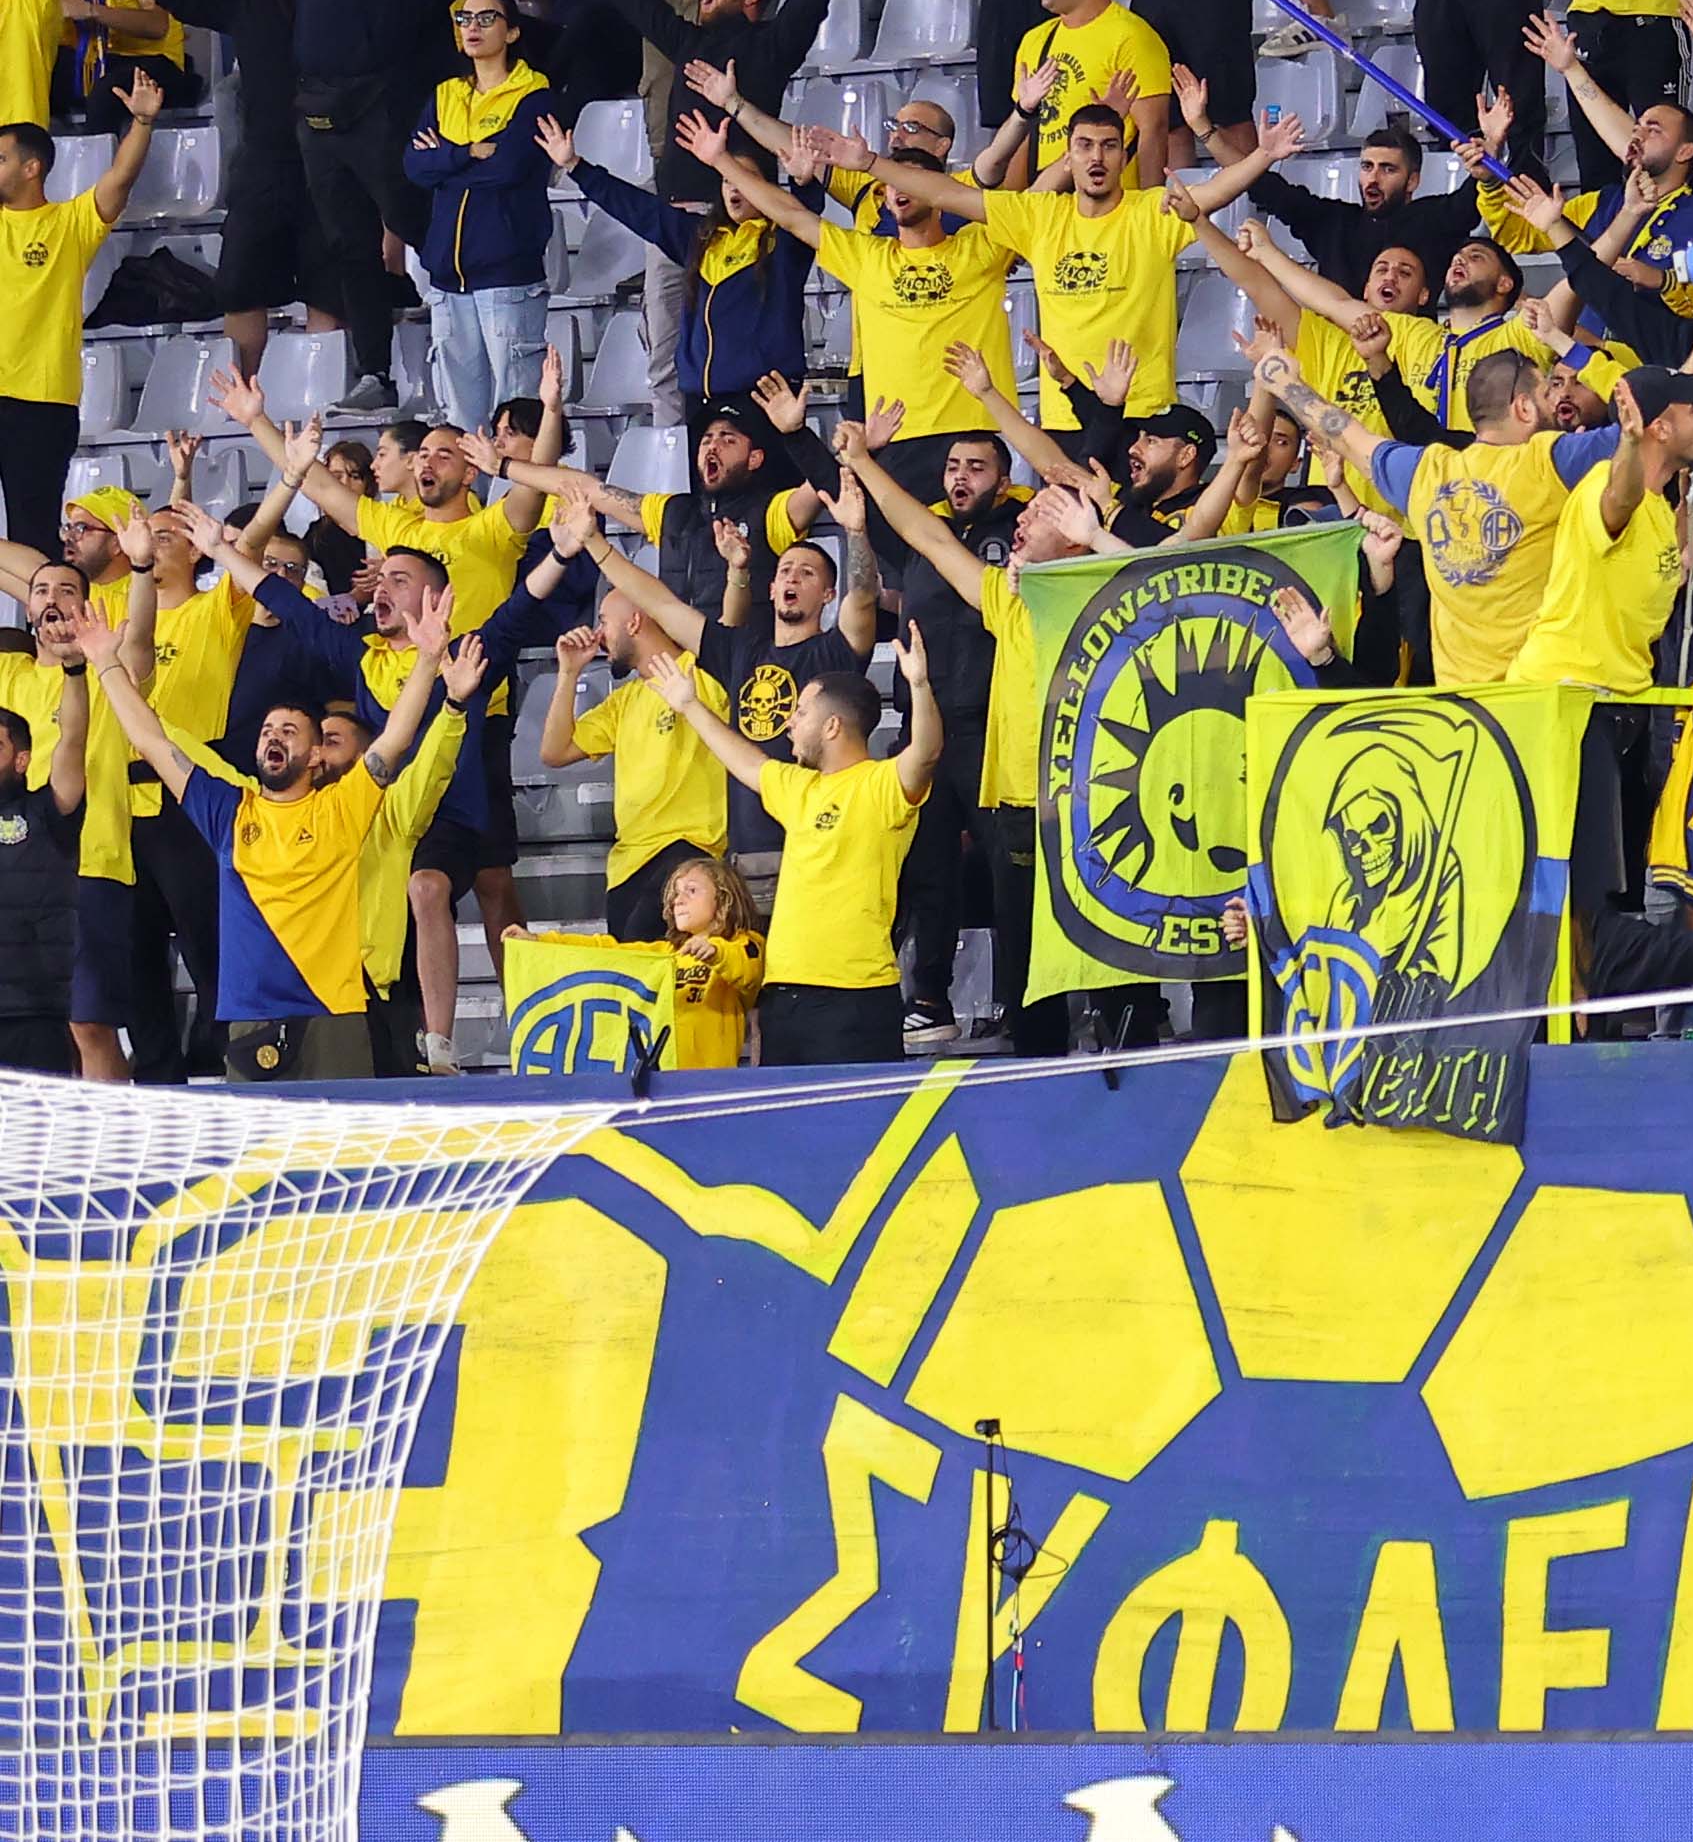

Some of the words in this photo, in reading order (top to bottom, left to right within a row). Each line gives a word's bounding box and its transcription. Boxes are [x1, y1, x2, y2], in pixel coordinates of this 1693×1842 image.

[1048, 591, 1139, 800] YELLOW
[1148, 562, 1271, 605] TRIBE
[1157, 915, 1247, 955] ES
